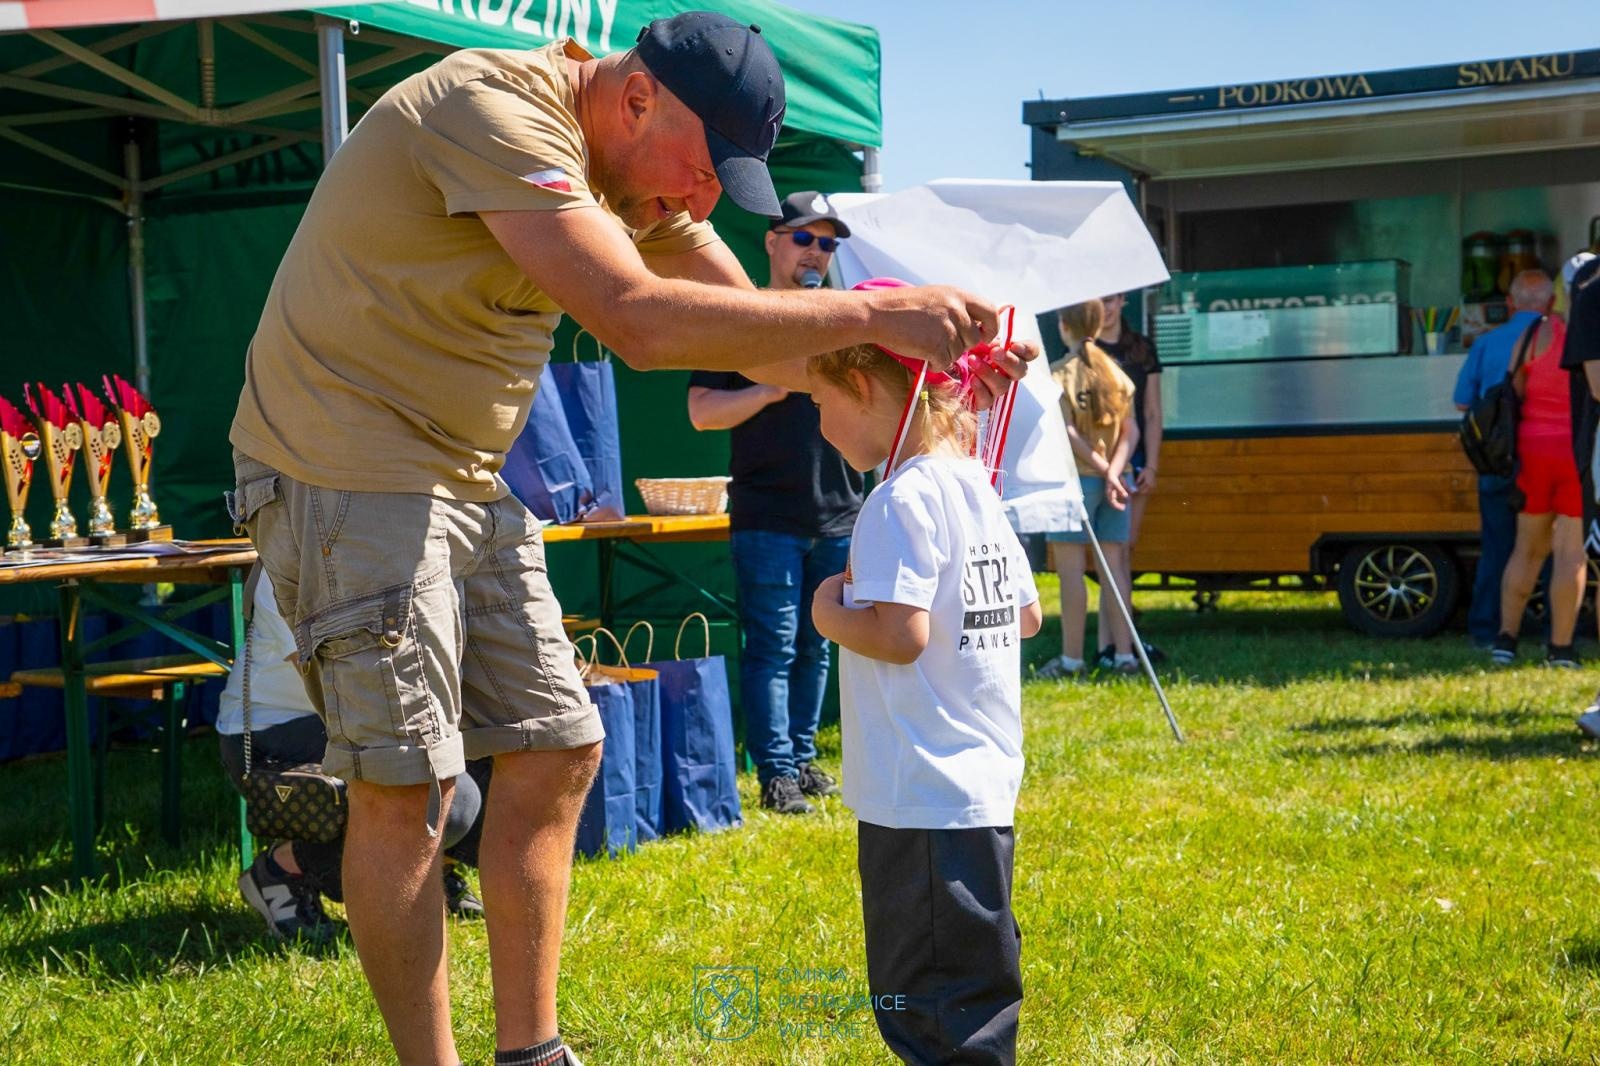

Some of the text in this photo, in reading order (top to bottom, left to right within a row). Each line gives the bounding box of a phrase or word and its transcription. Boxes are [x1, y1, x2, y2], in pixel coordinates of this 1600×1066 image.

[407, 0, 617, 51] DZINY
[1218, 52, 1575, 107] PODKOWA SMAKU
